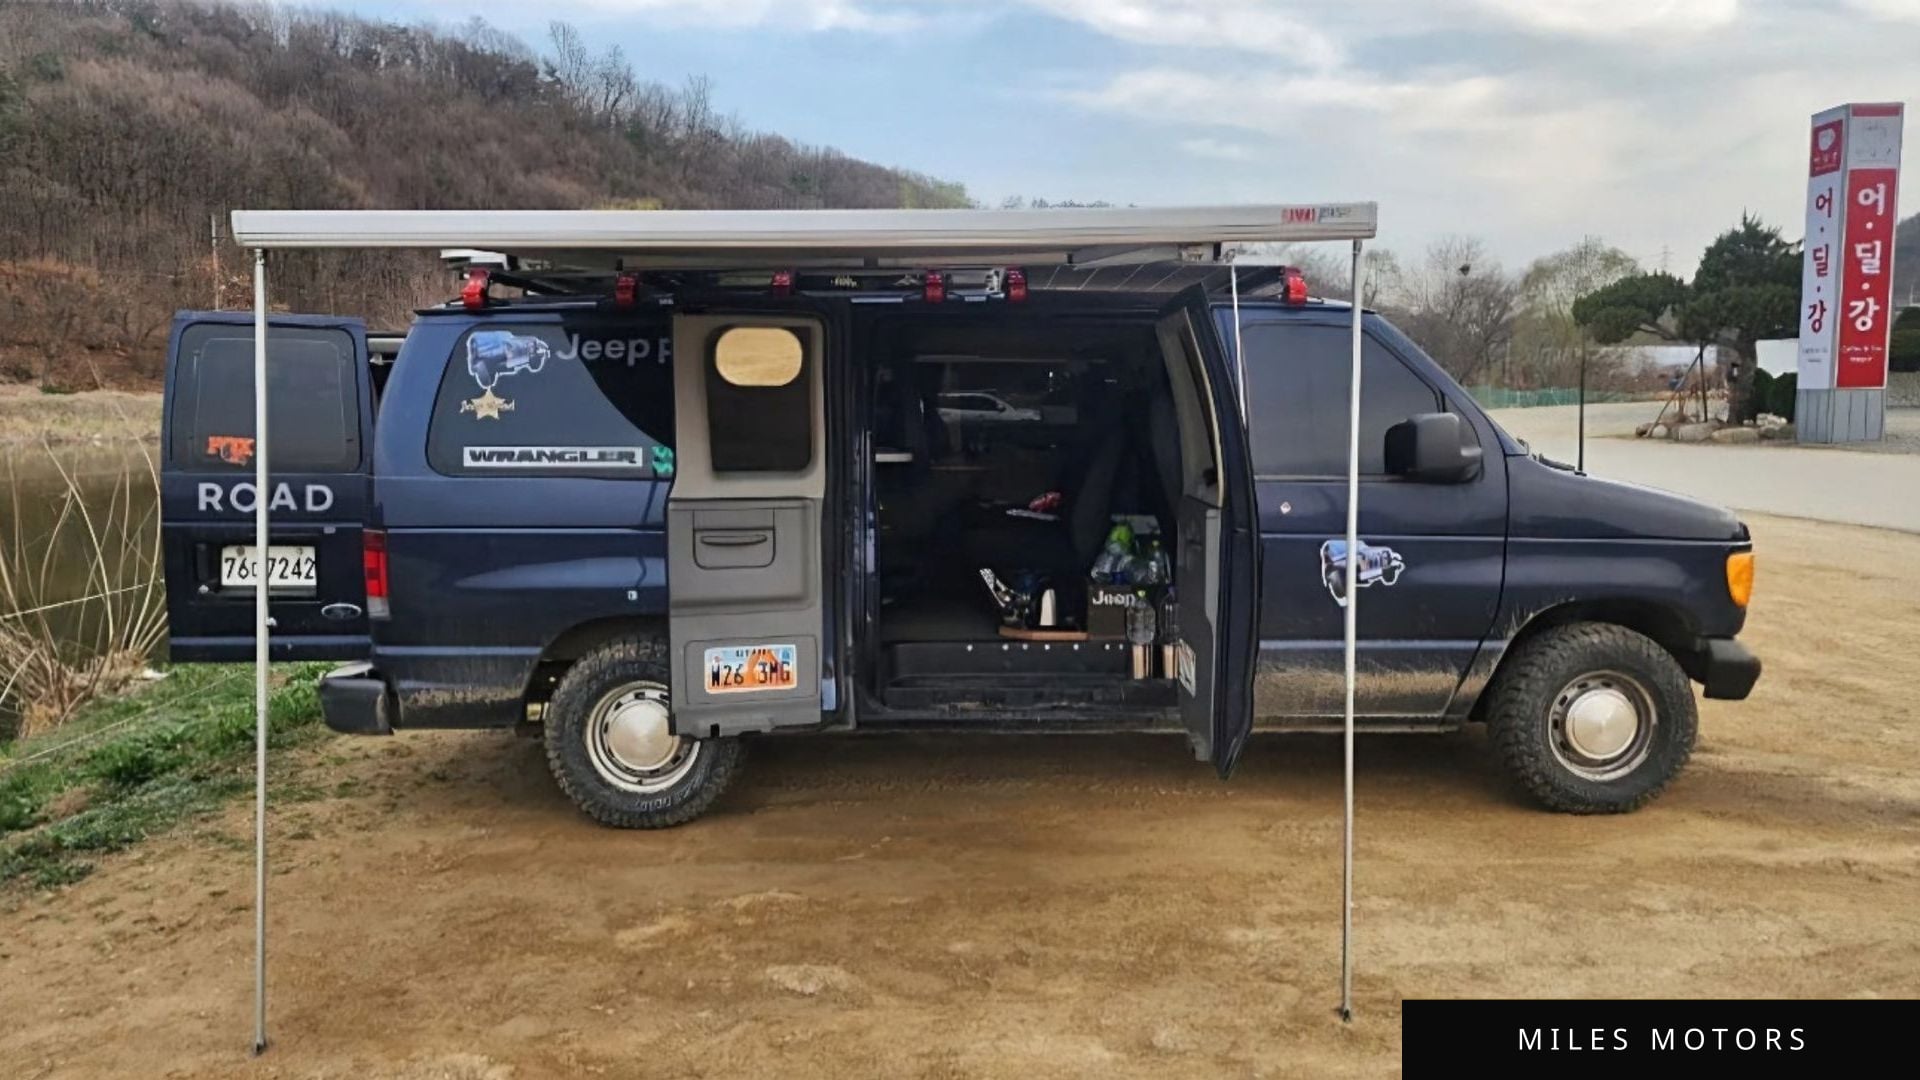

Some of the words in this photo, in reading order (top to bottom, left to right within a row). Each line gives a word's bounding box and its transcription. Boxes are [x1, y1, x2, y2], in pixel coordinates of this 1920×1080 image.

[555, 333, 650, 366] Jeep
[469, 449, 637, 464] WRANGLER
[198, 482, 333, 513] ROAD
